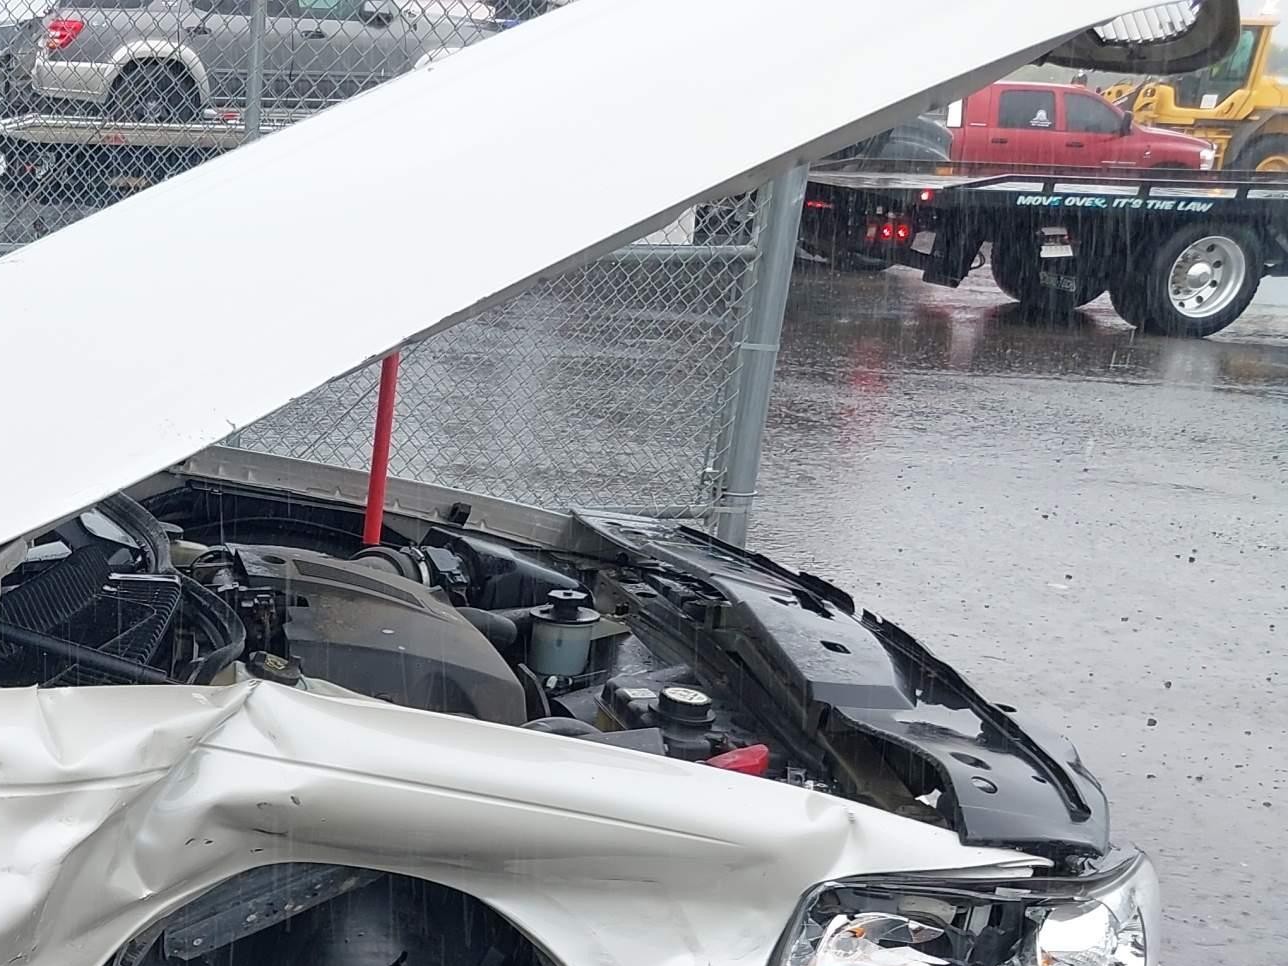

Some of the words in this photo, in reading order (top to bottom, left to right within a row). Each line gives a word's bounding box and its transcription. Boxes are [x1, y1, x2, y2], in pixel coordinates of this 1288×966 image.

[1016, 195, 1062, 206] MOVE
[1064, 197, 1108, 208] OVER,
[1112, 198, 1144, 209] IT'S
[1146, 199, 1176, 210] THE
[1176, 202, 1213, 212] LAW
